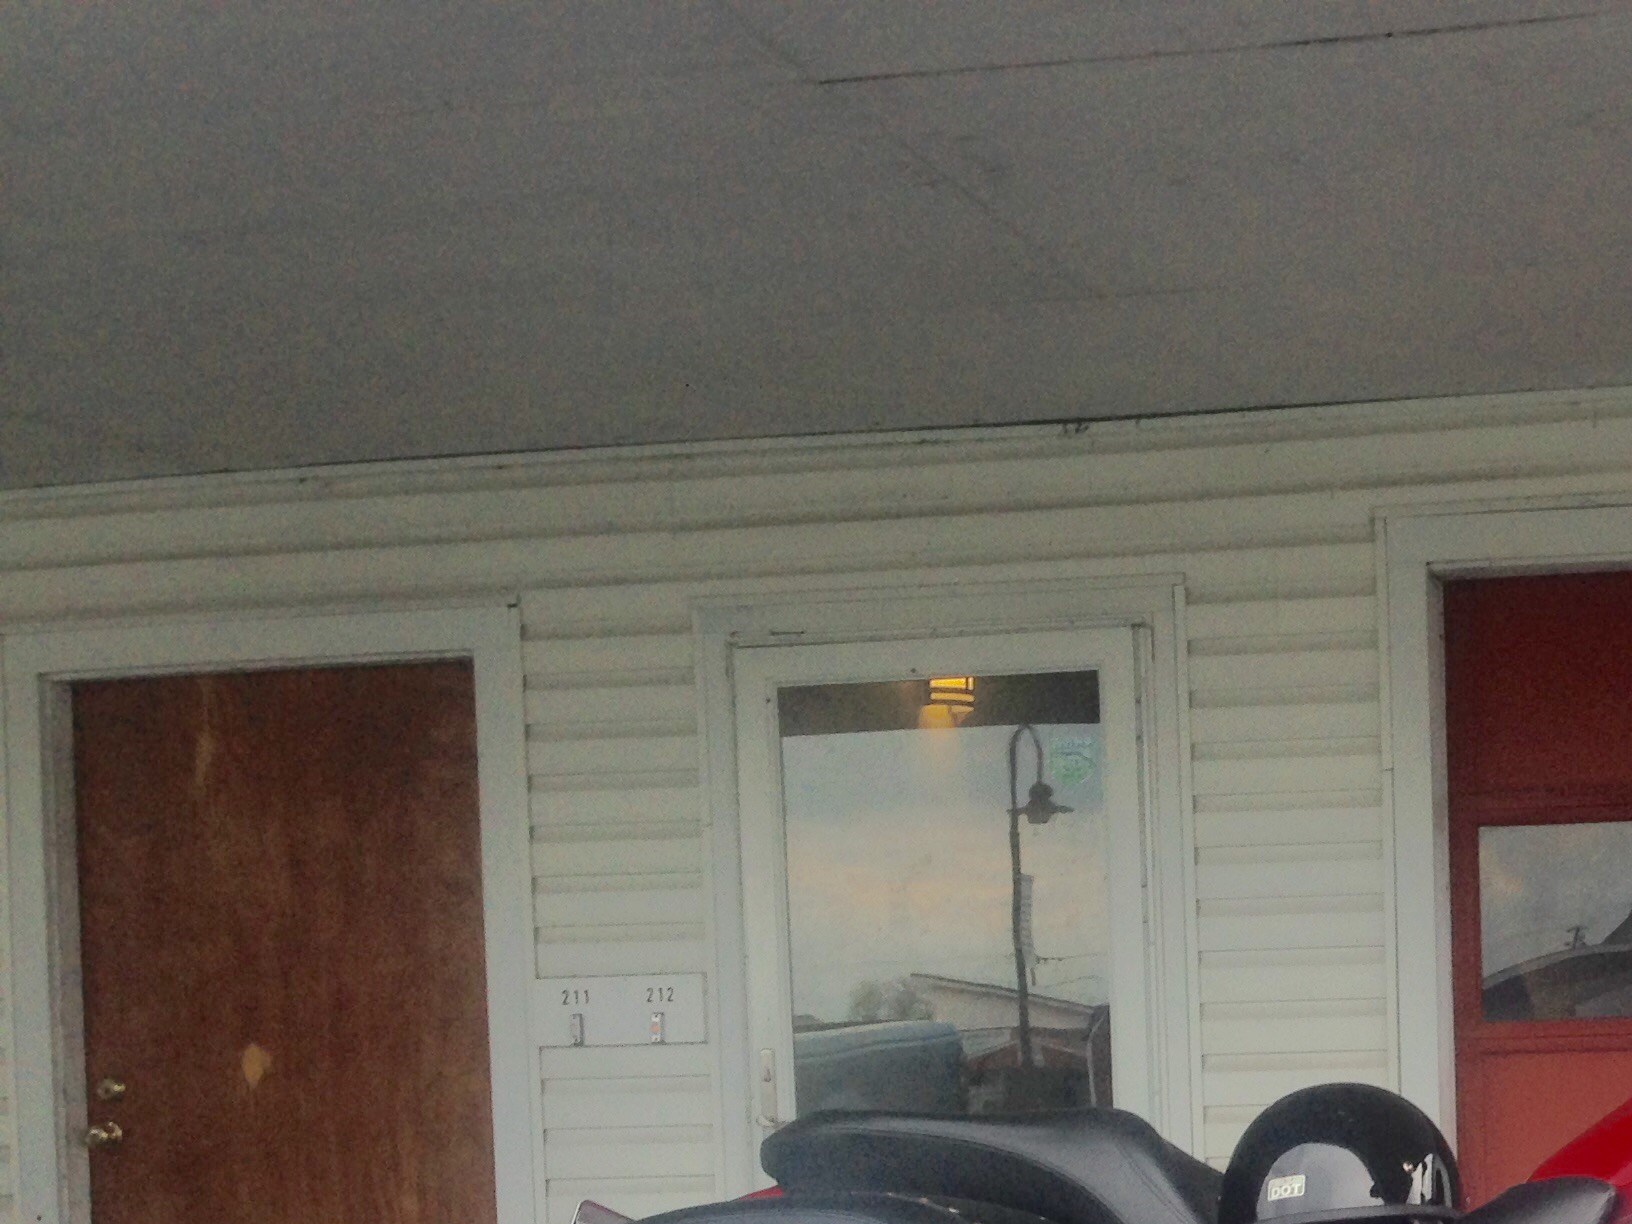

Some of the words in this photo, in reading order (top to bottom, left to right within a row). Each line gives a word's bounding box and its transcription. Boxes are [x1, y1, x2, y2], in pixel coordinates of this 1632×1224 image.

[562, 989, 590, 1006] 211
[646, 986, 674, 1003] 212
[1271, 1183, 1302, 1199] DOT
